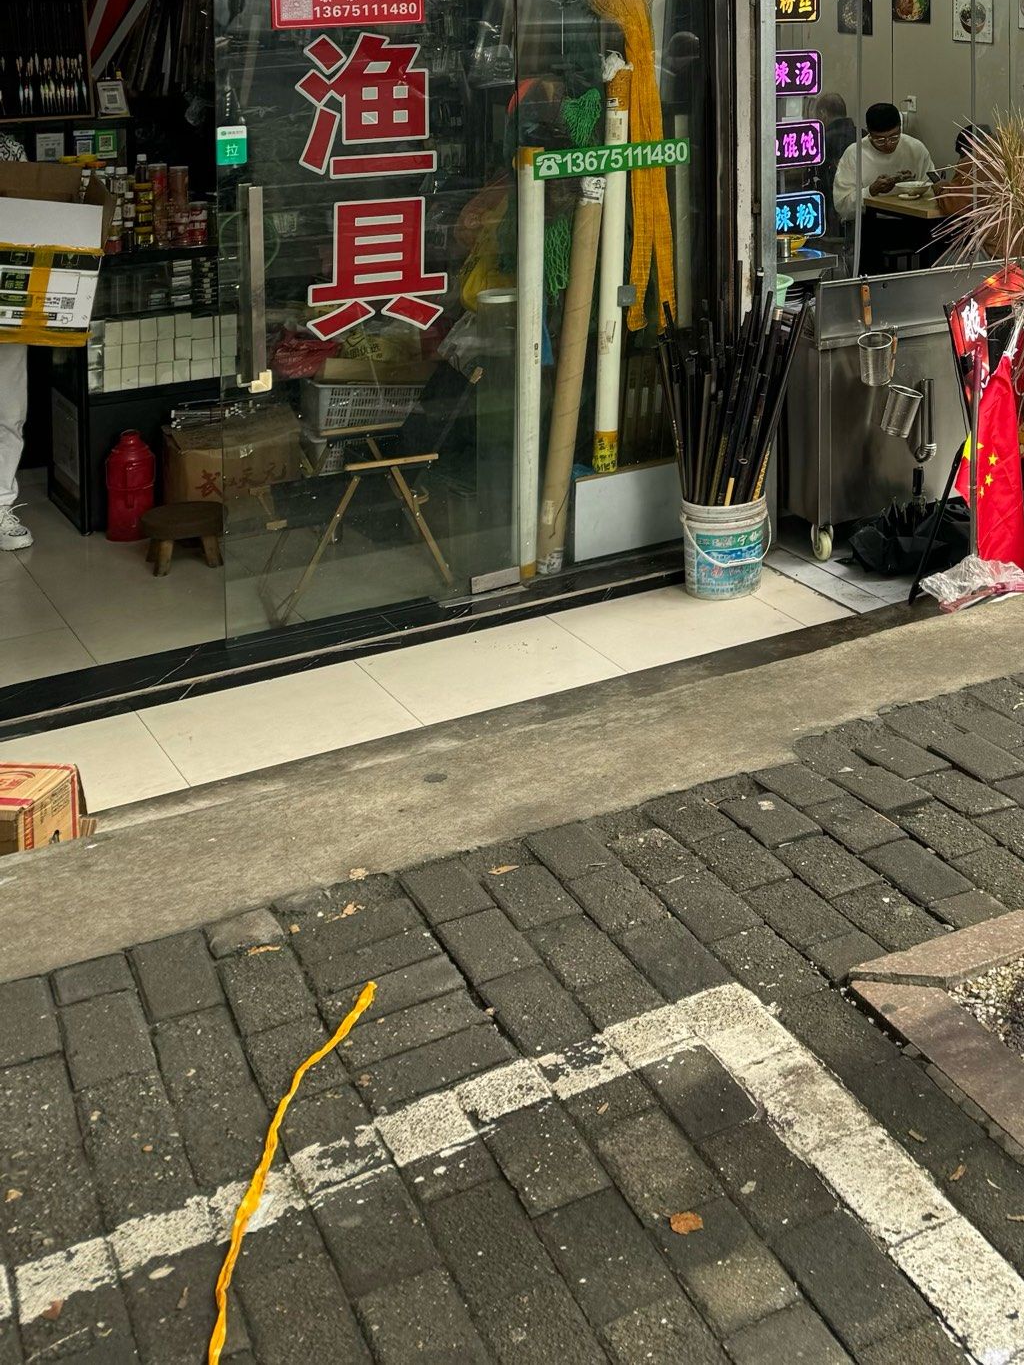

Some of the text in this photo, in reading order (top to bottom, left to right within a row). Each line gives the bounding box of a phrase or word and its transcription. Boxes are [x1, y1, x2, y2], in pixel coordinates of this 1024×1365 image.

[313, 2, 418, 19] 13675111480
[225, 144, 239, 157] 拉
[562, 142, 689, 174] 13675111480
[775, 131, 817, 158] 馄饨
[296, 32, 448, 341] 渔具
